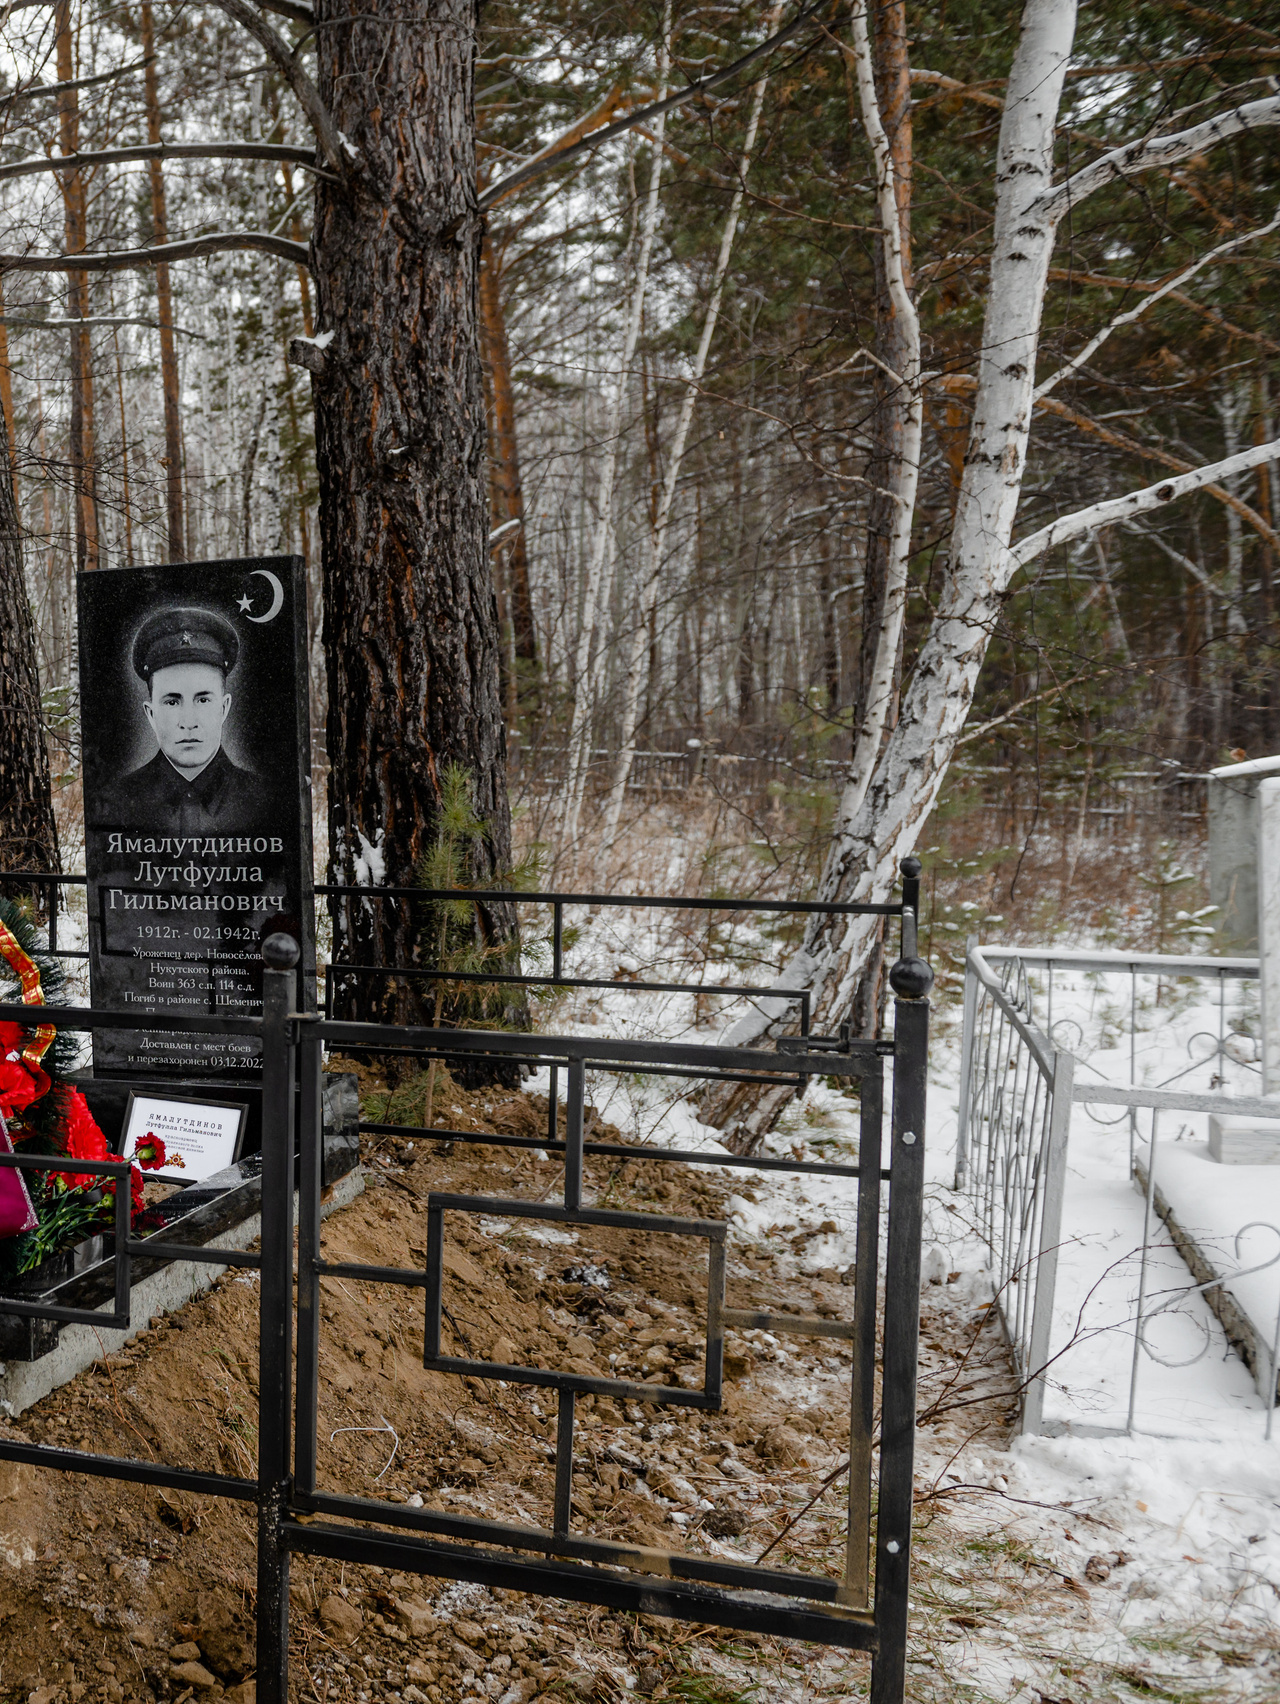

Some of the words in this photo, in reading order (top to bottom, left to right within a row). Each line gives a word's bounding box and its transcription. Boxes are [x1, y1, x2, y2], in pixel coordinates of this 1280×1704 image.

[107, 833, 284, 858] Ямалутдинов
[134, 861, 263, 887] Лутфулла
[109, 889, 284, 911] Гильманович
[137, 926, 181, 939] 1912г.
[193, 927, 261, 940] 02.1942г.
[132, 947, 181, 960] Уроженец
[183, 950, 203, 961] дер.
[150, 963, 209, 976] Нукутского
[212, 965, 250, 977] района.
[149, 978, 175, 990] Воин
[177, 978, 196, 989] 363
[219, 980, 234, 990] 114
[124, 992, 156, 1003] Погиб
[167, 995, 200, 1006] районе
[215, 995, 264, 1007] Шеменич
[140, 1038, 192, 1052] Доставлен
[203, 1044, 225, 1052] мест
[228, 1042, 251, 1053] боев
[137, 1055, 208, 1066] перезахоронен
[148, 1113, 223, 1130] ЯМАЛУТДИНОВ
[145, 1121, 178, 1131] Лутфулла
[179, 1126, 223, 1138] Гильманович
